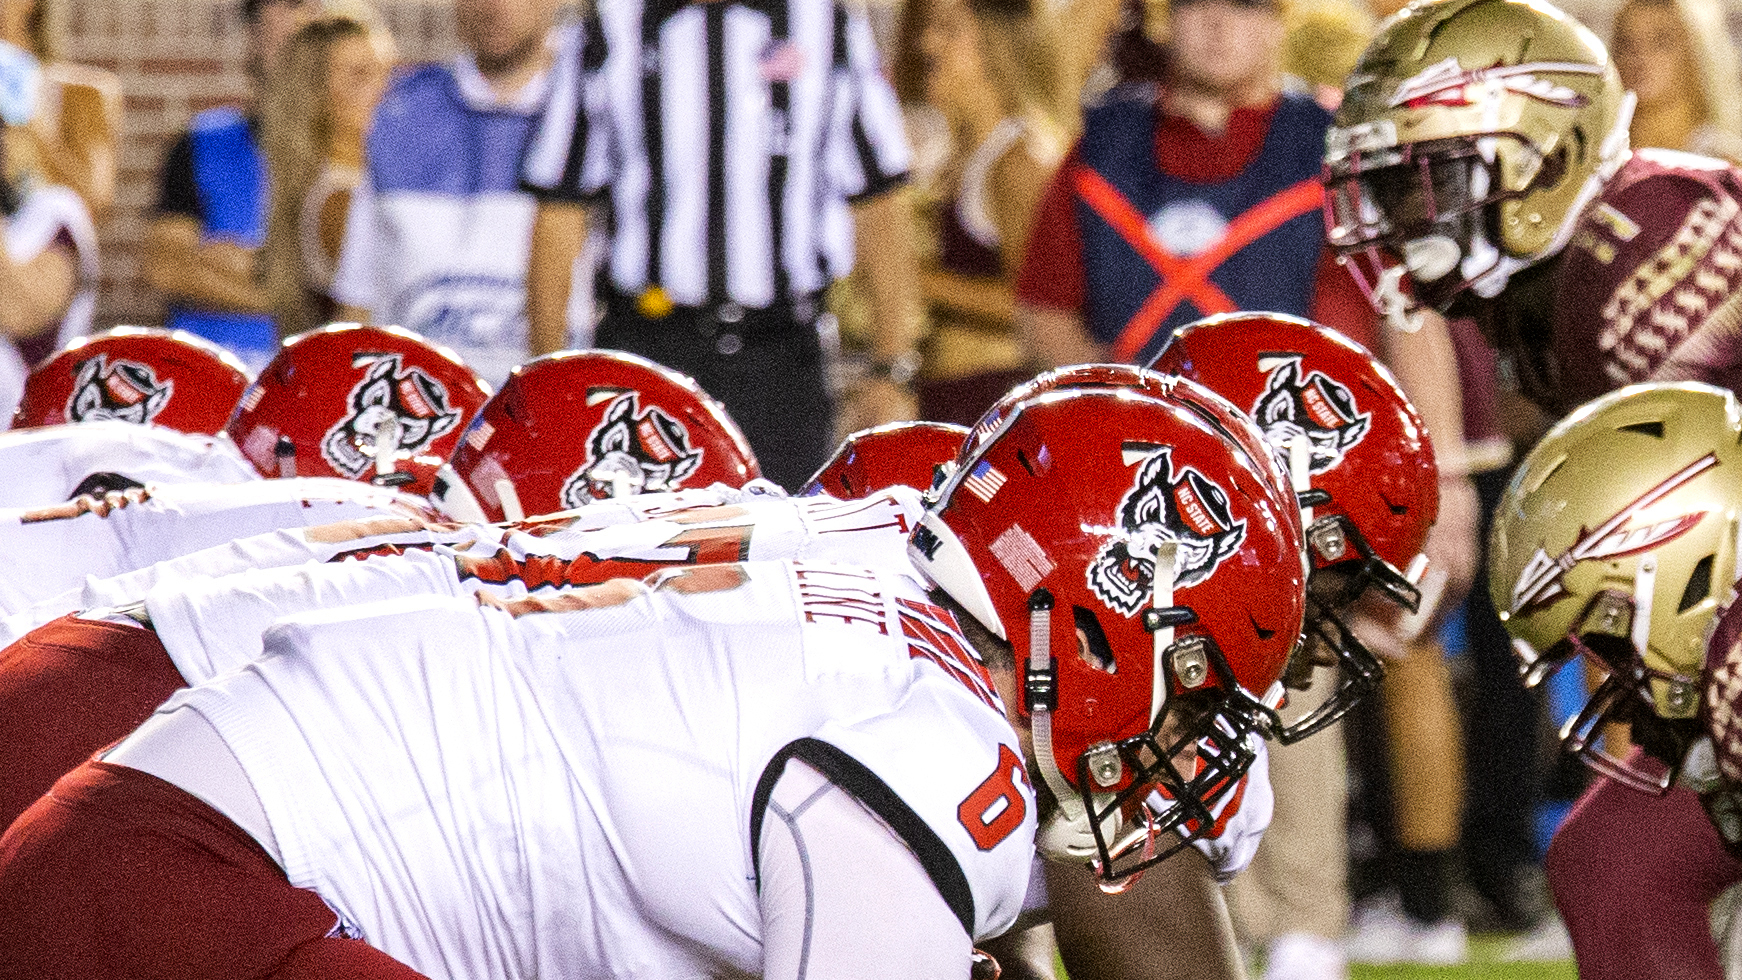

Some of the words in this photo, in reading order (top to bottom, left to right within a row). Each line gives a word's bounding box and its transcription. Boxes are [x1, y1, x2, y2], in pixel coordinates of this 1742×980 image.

[1177, 486, 1190, 505] NC
[1186, 501, 1216, 534] STATE
[956, 742, 1034, 852] 6
